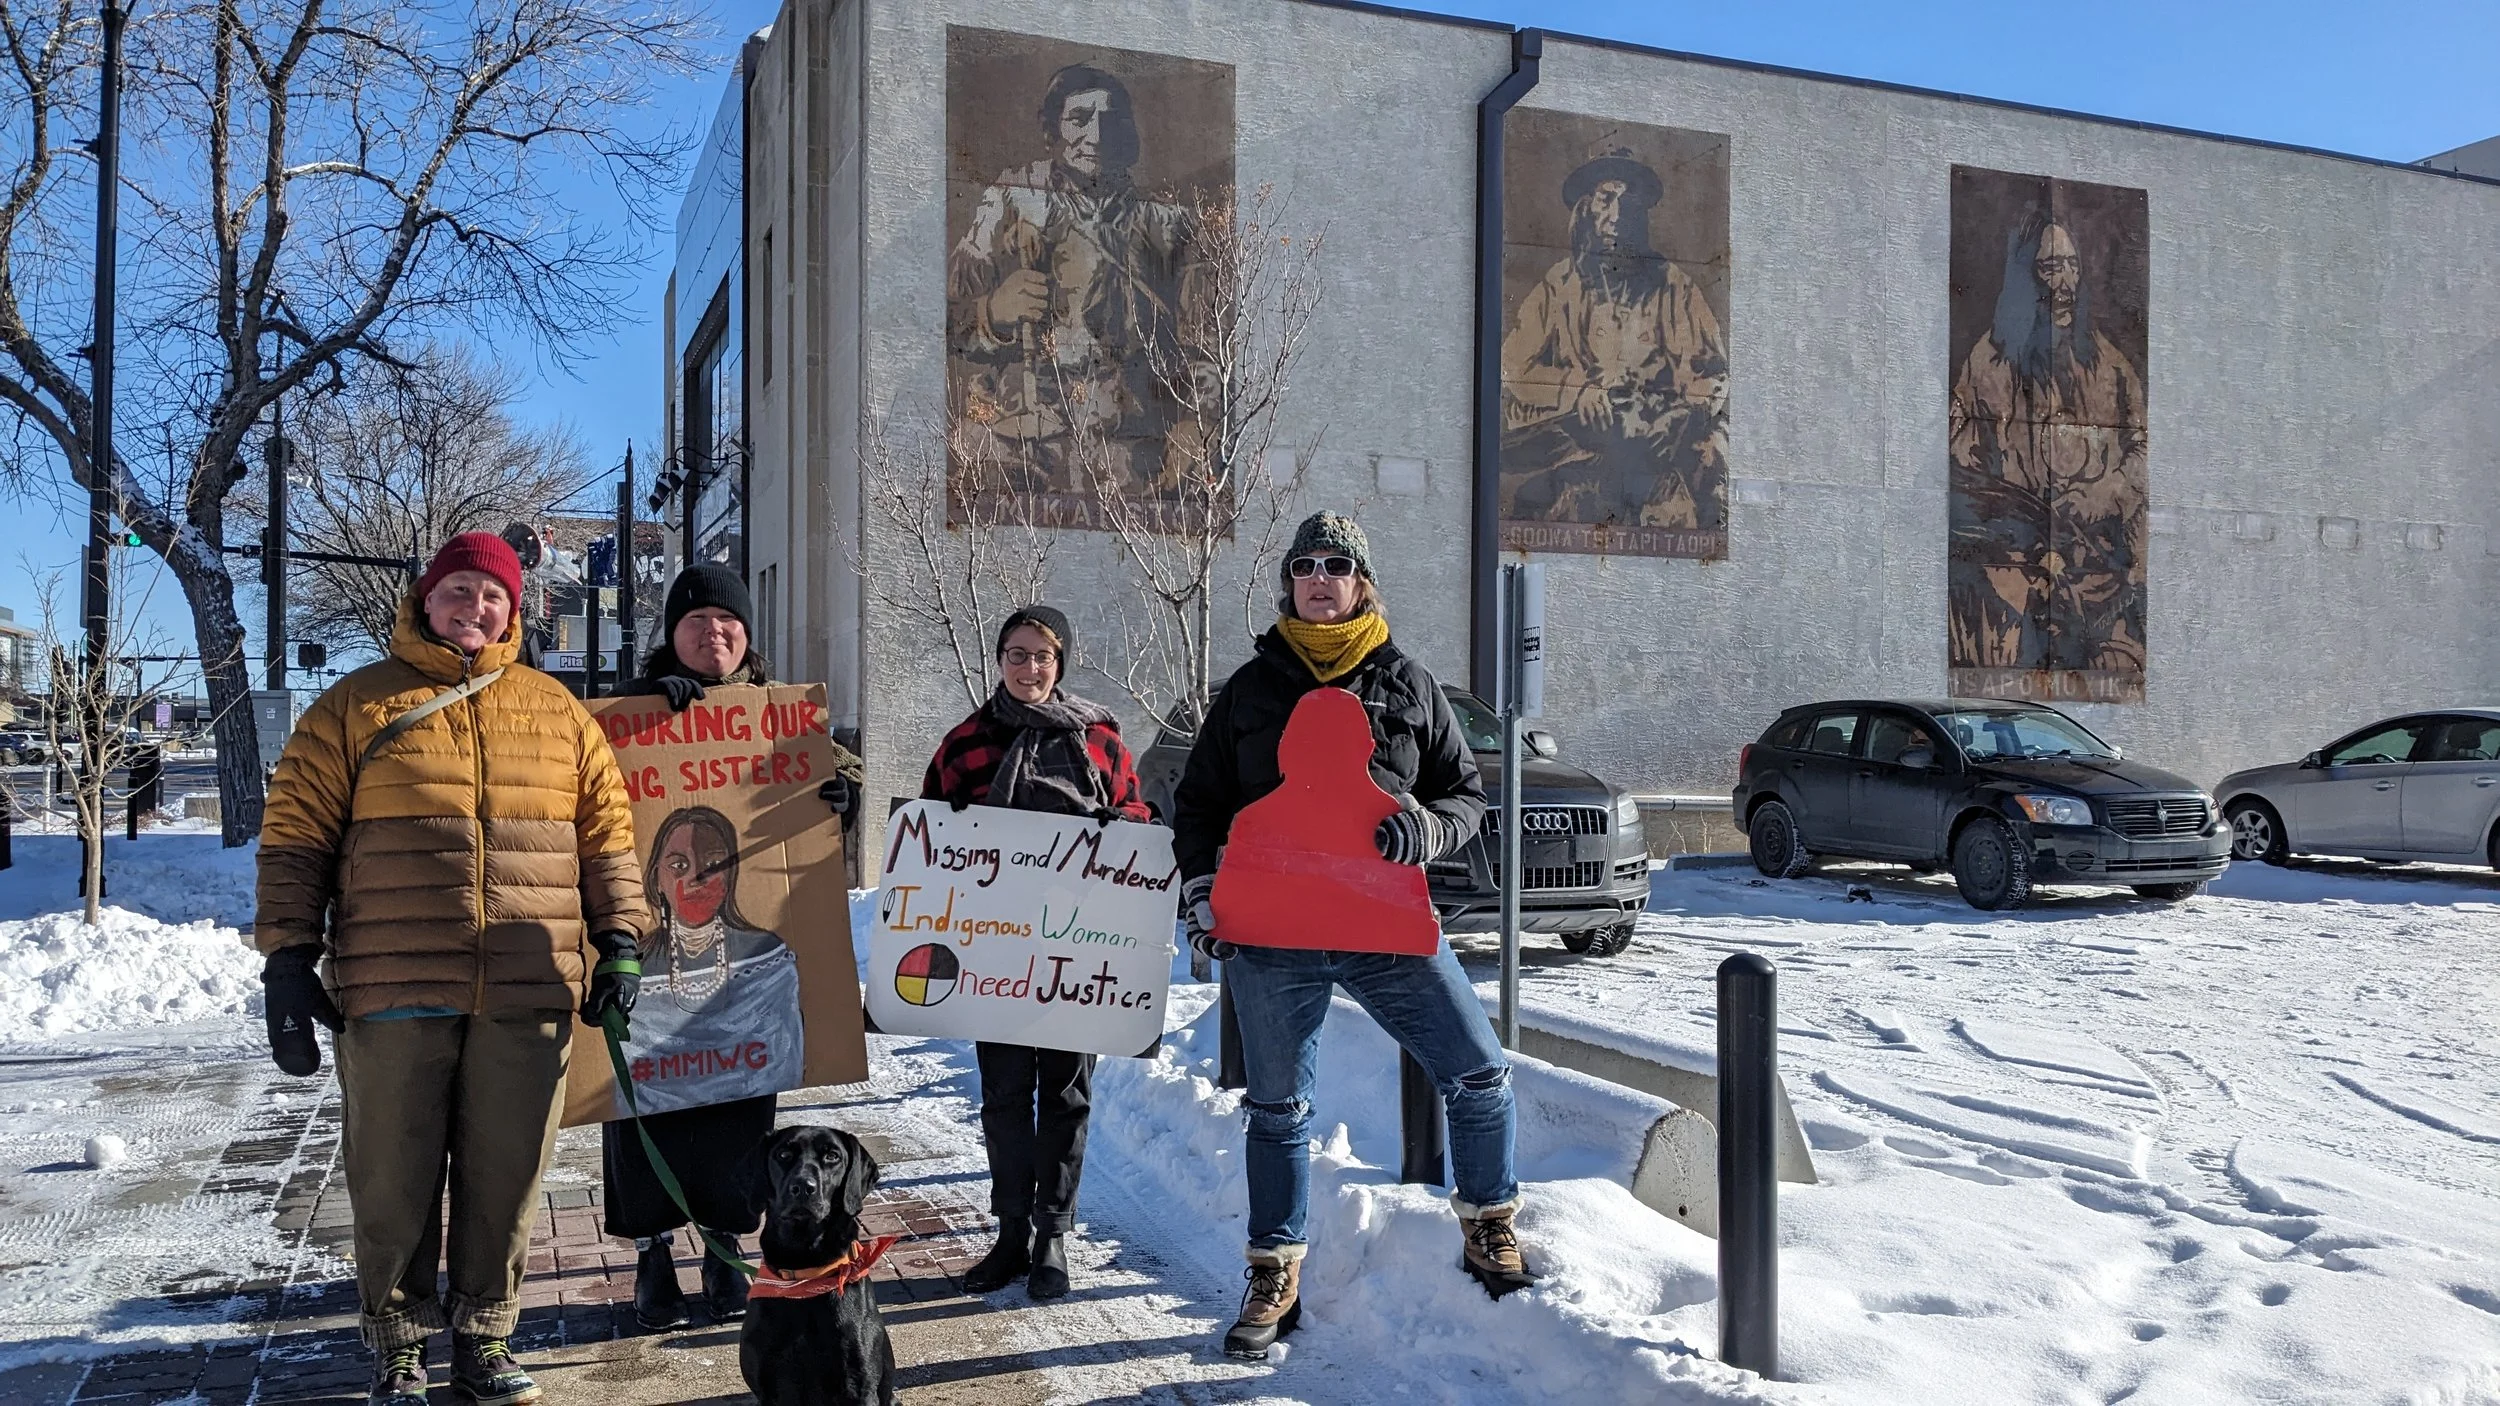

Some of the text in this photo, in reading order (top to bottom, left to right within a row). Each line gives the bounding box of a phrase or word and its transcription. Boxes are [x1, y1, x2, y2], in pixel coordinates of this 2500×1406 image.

[560, 656, 583, 667] Pita
[760, 700, 828, 740] OUR
[679, 751, 811, 792] SISTERS
[886, 808, 1000, 887] Missing
[1057, 828, 1179, 892] Murdered
[890, 886, 1137, 949] Indigenous Woman
[959, 955, 1036, 998] need
[631, 1041, 768, 1082] #MMIWG
